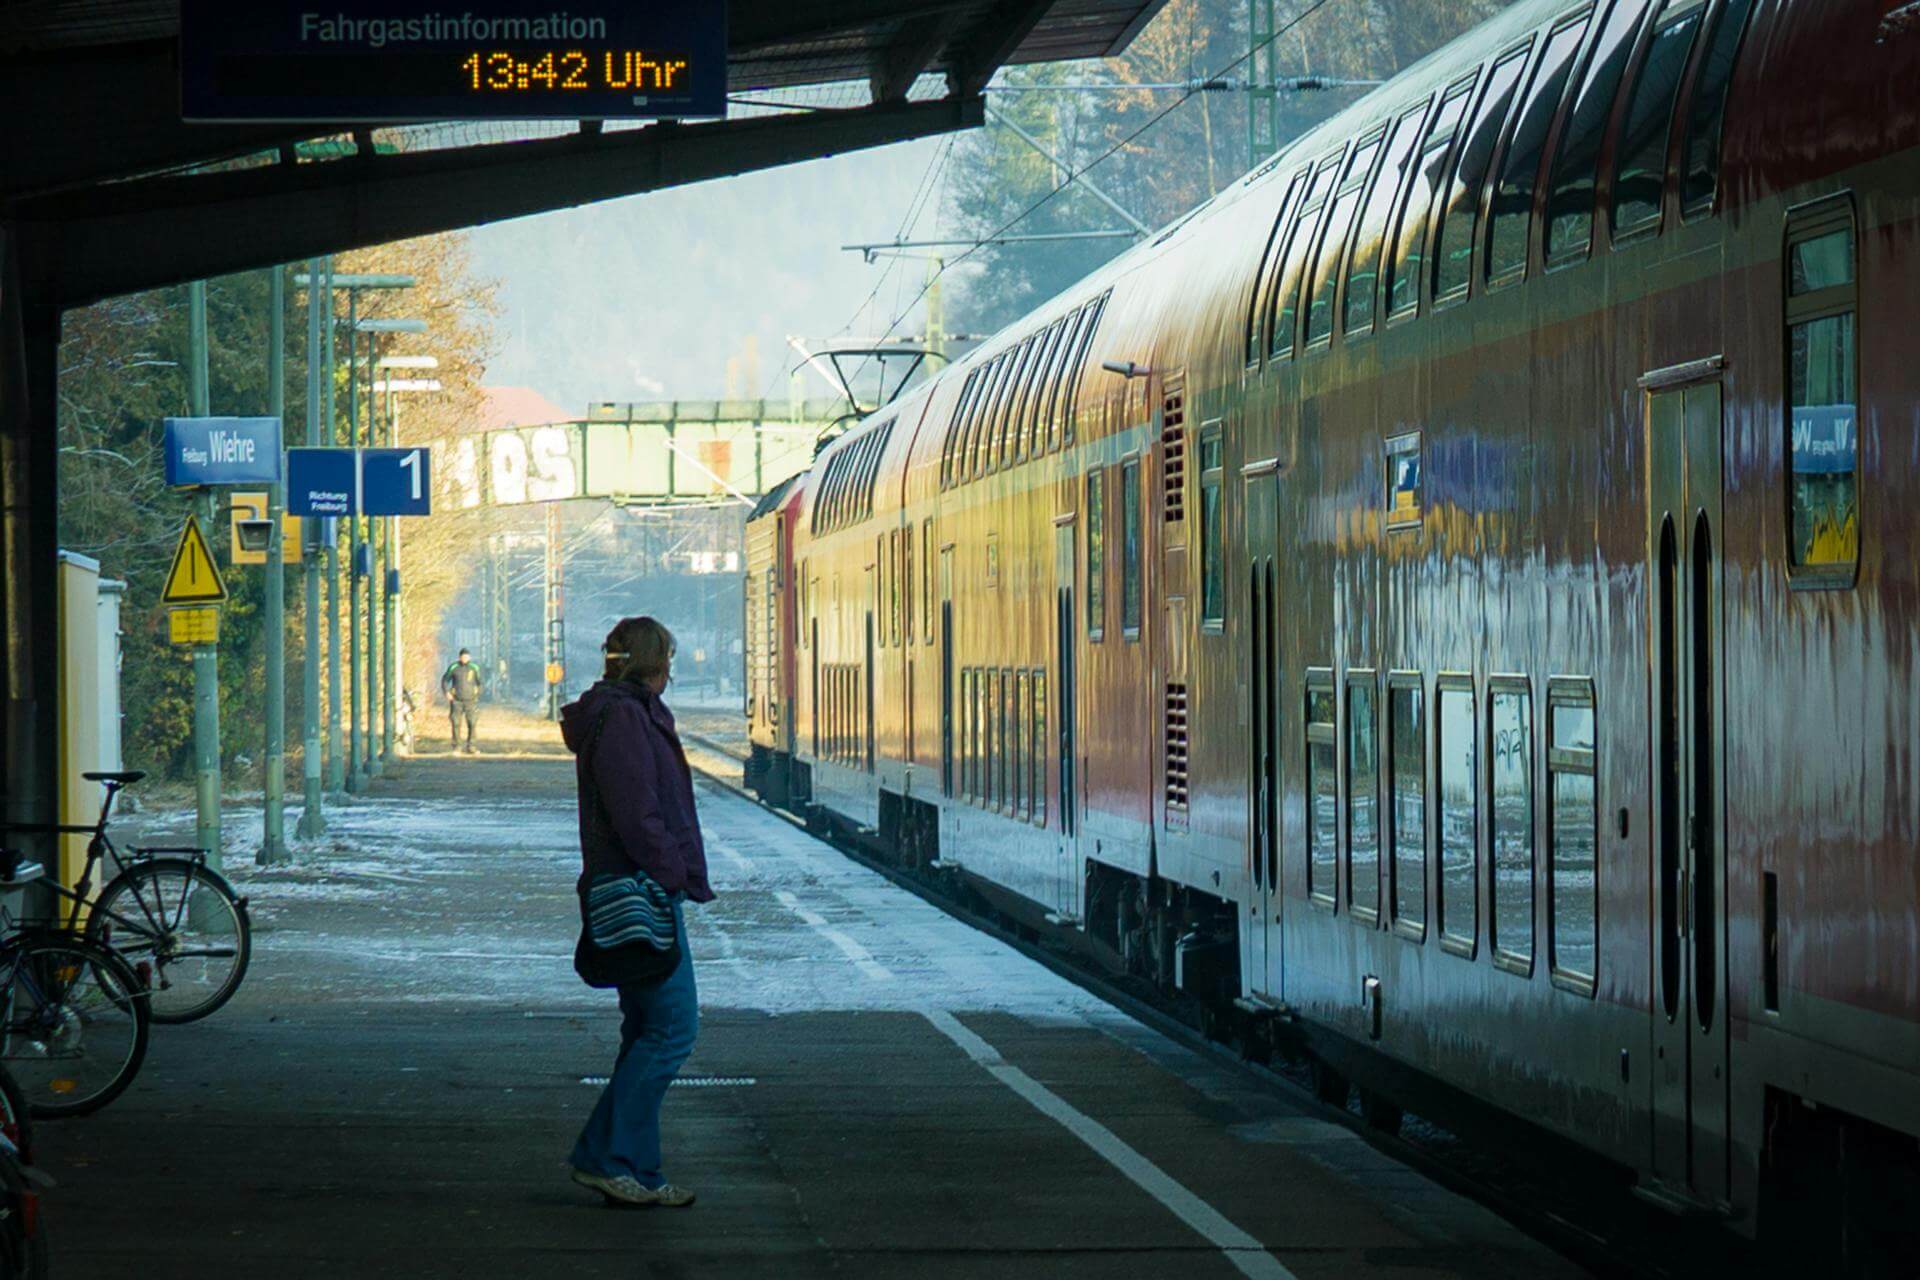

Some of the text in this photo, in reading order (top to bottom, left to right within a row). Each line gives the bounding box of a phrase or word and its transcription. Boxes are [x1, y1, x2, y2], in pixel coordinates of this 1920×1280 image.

[301, 12, 607, 47] Fahrgastinformation
[462, 51, 688, 89] 13:42 Uhr
[208, 430, 255, 463] Wiehre
[400, 449, 421, 499] 1
